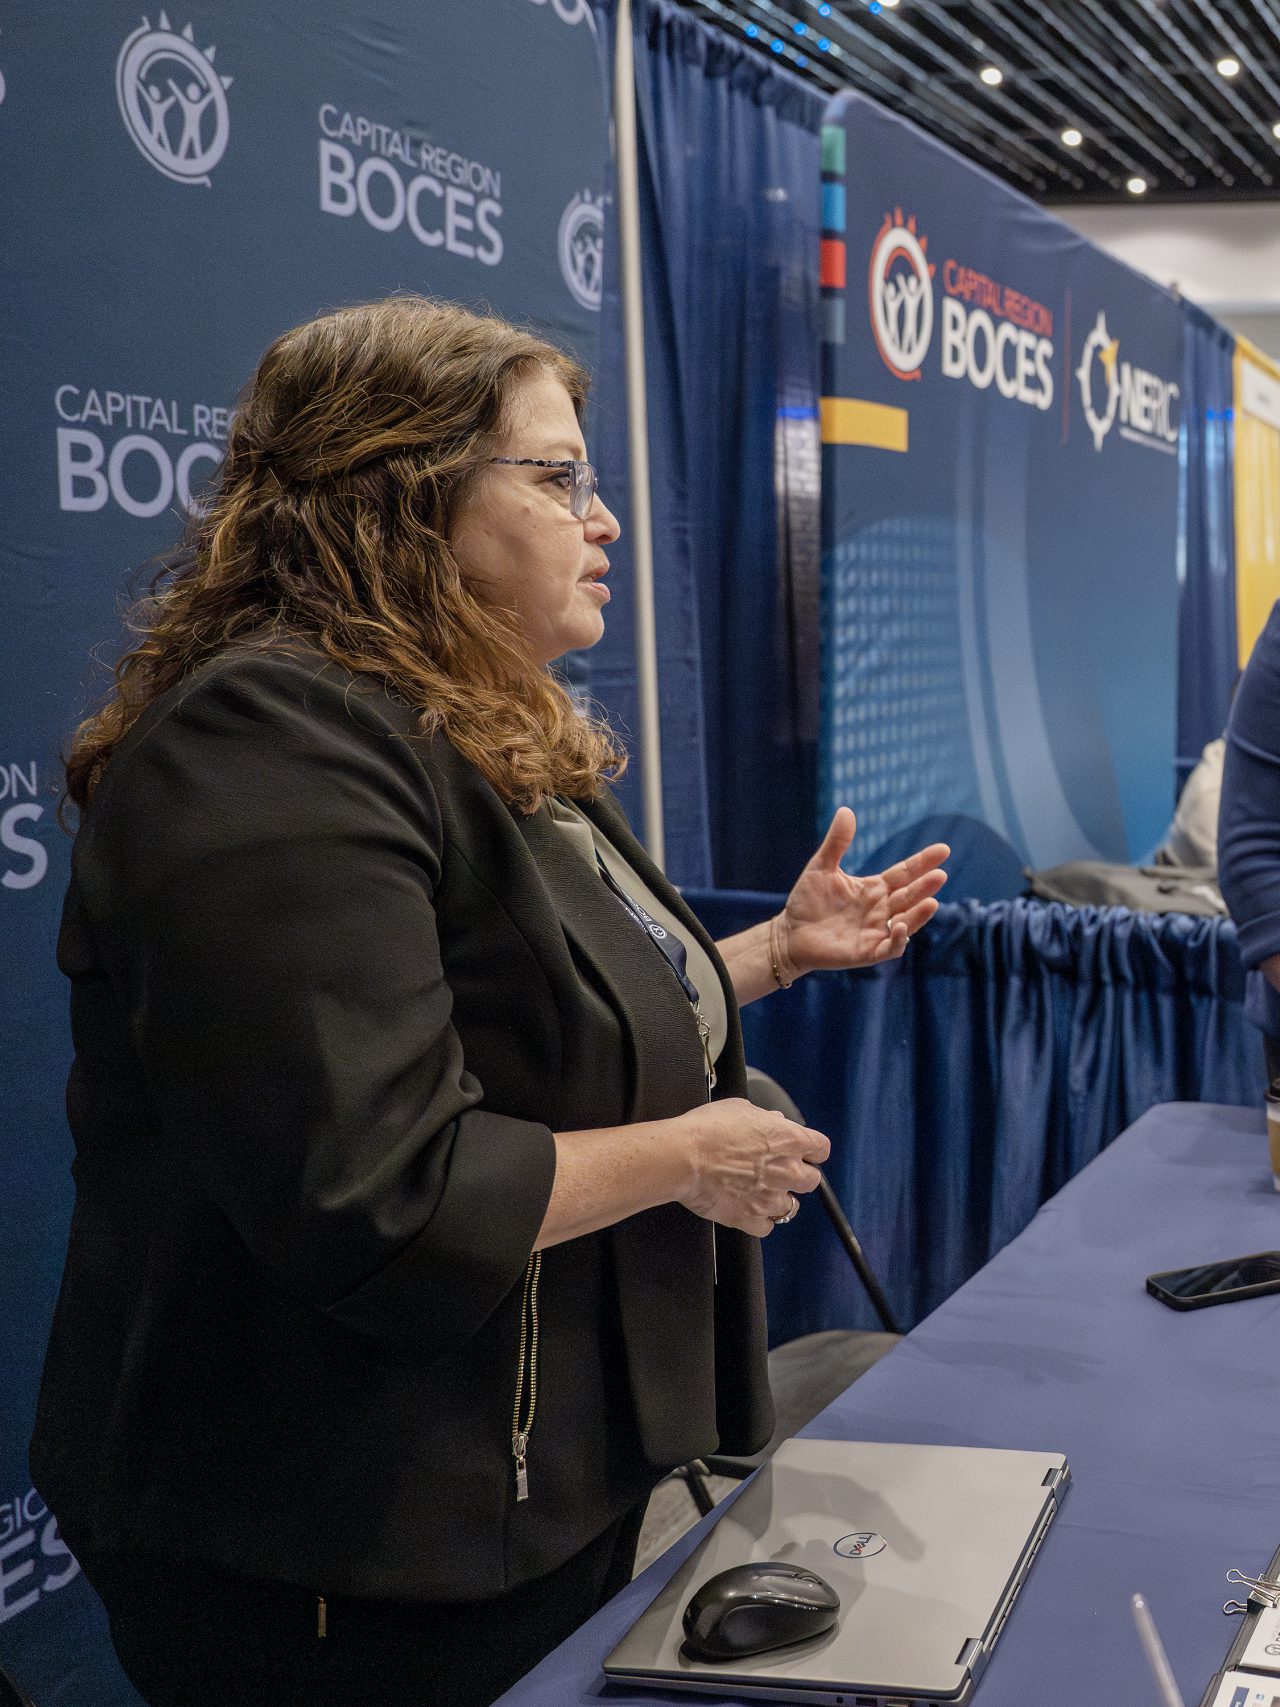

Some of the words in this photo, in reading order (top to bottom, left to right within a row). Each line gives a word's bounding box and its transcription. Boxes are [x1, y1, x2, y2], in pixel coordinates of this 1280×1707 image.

[318, 103, 418, 167] CAPITAL
[420, 143, 501, 198] REGION
[318, 139, 504, 266] BOCES
[942, 297, 1054, 411] BOCES
[55, 384, 188, 435] CAPITAL
[1119, 363, 1180, 443] NERIC
[56, 427, 226, 519] BOC
[849, 1535, 873, 1555] DELL
